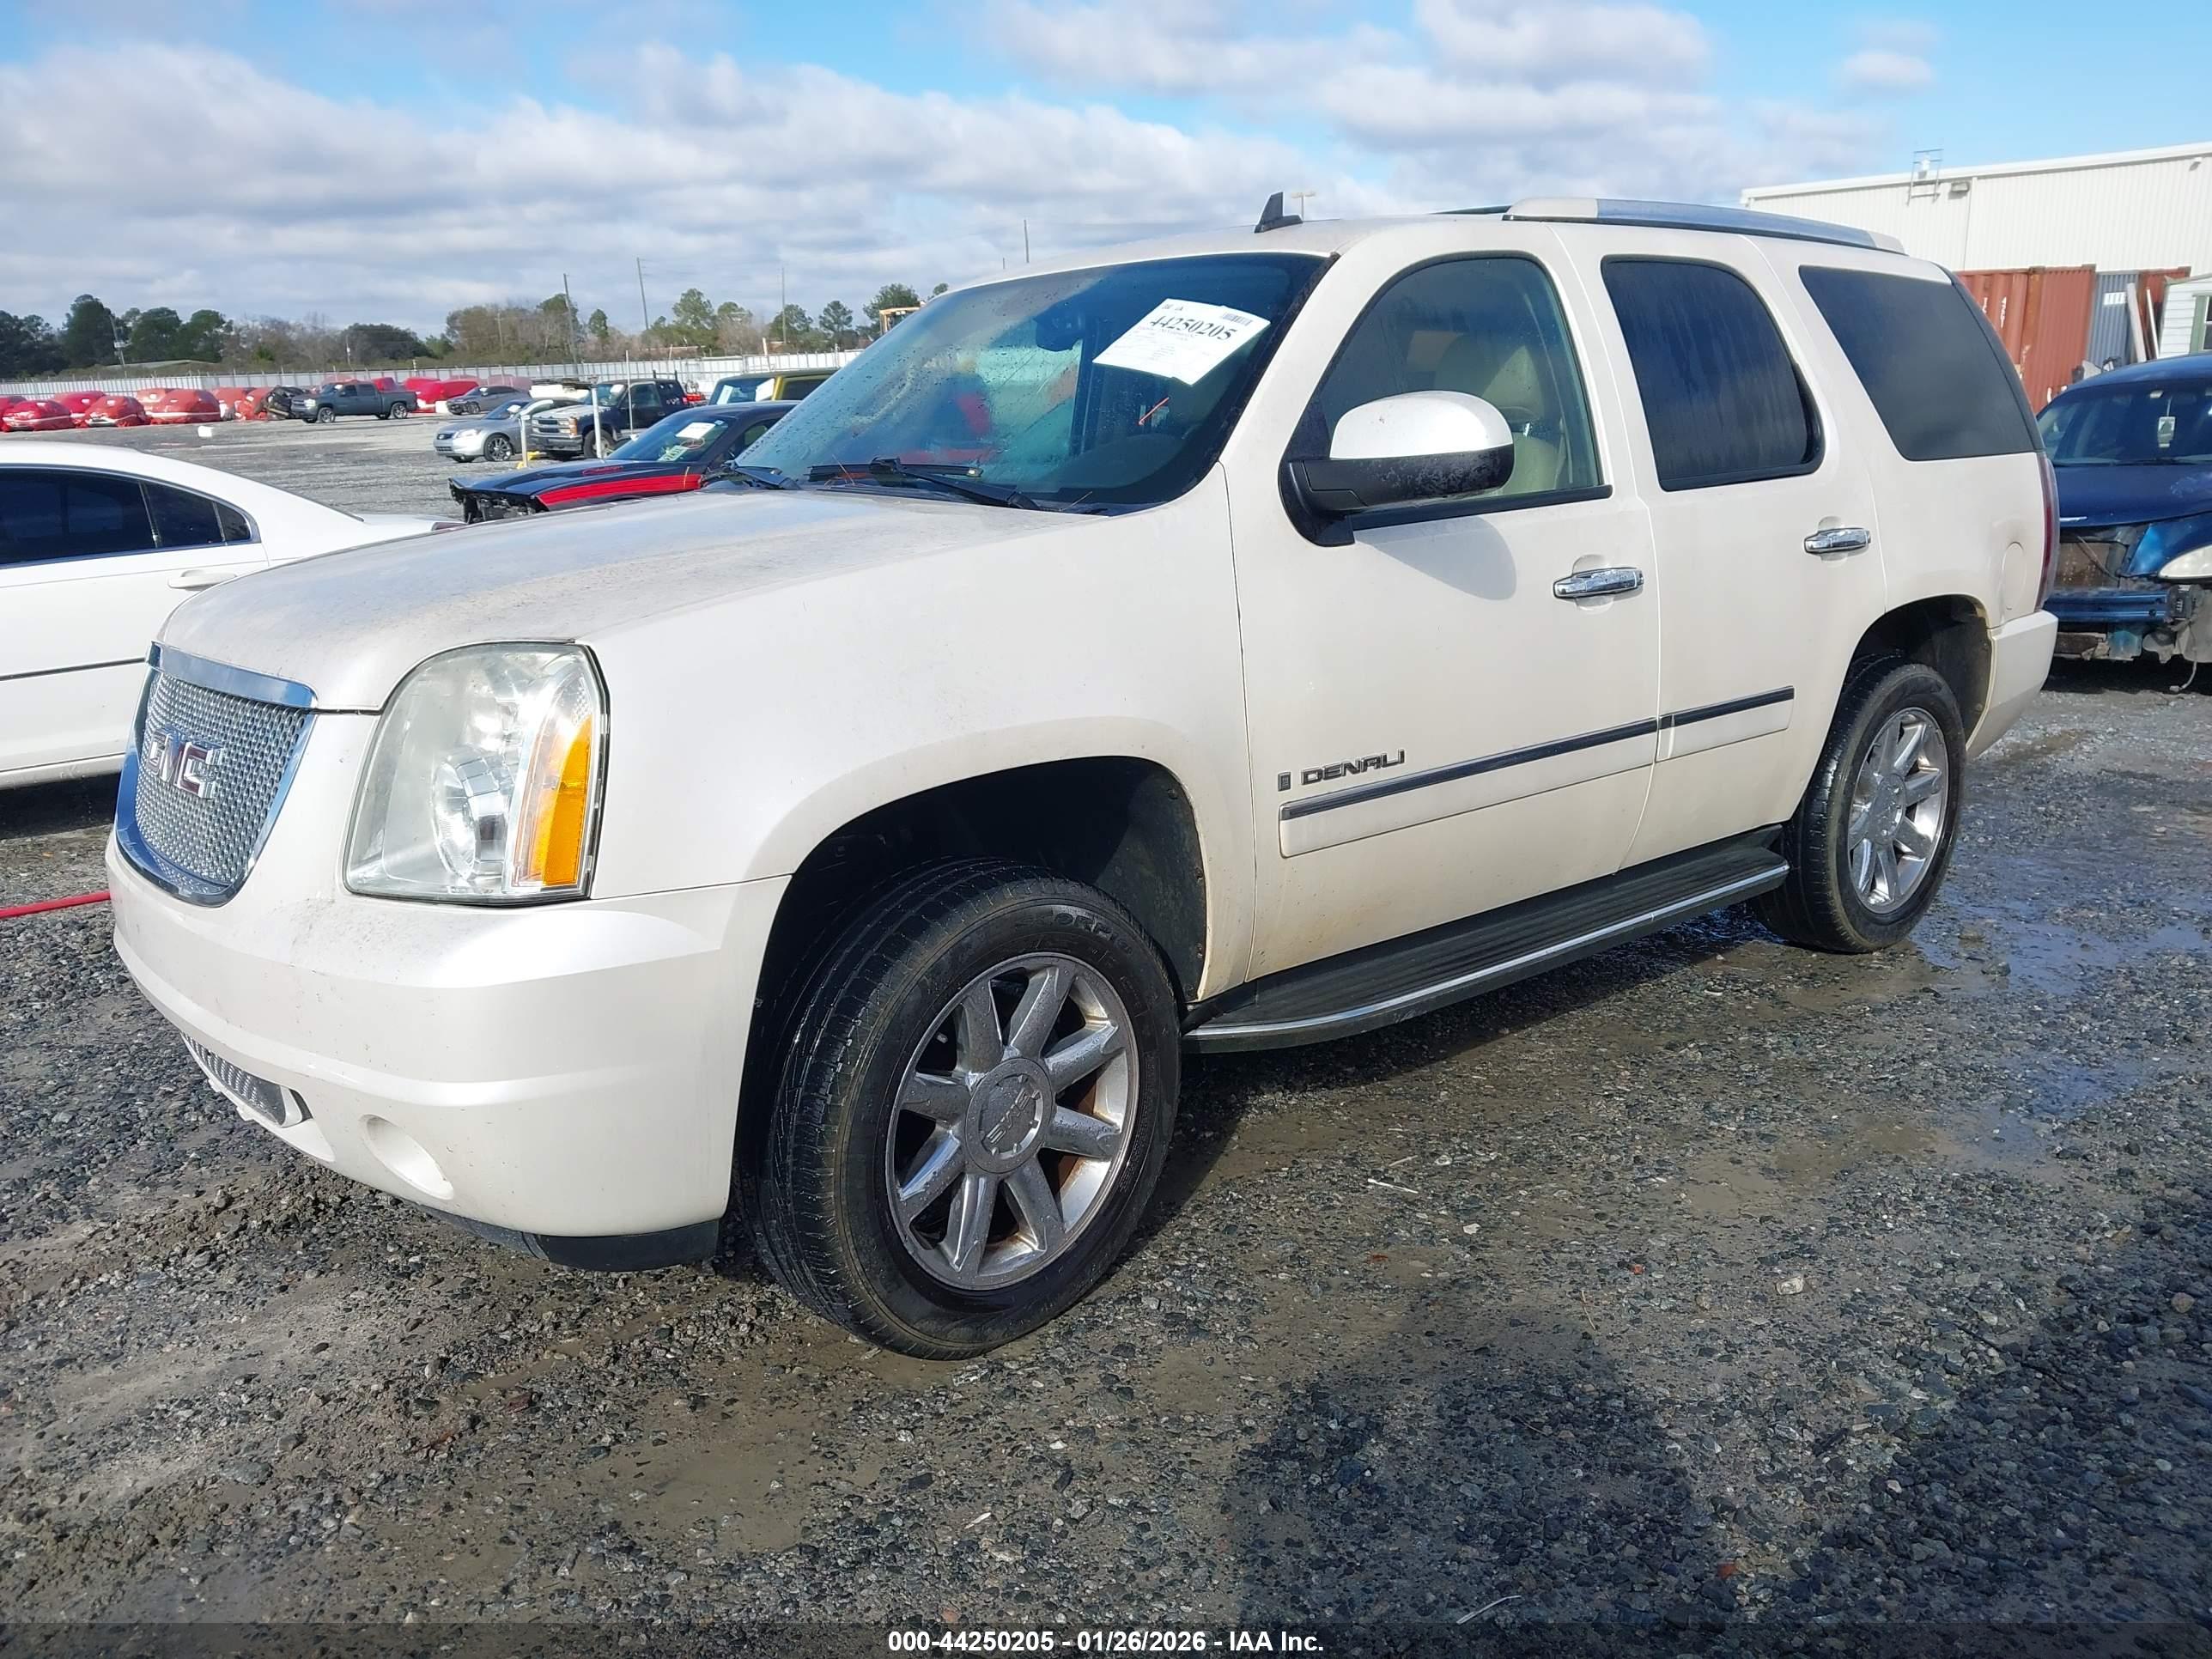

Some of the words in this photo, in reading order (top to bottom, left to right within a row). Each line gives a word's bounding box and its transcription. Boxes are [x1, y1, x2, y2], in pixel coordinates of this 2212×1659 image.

[1150, 315, 1237, 340] 44250205
[147, 729, 228, 799] GMC
[1301, 749, 1405, 785] DENALI
